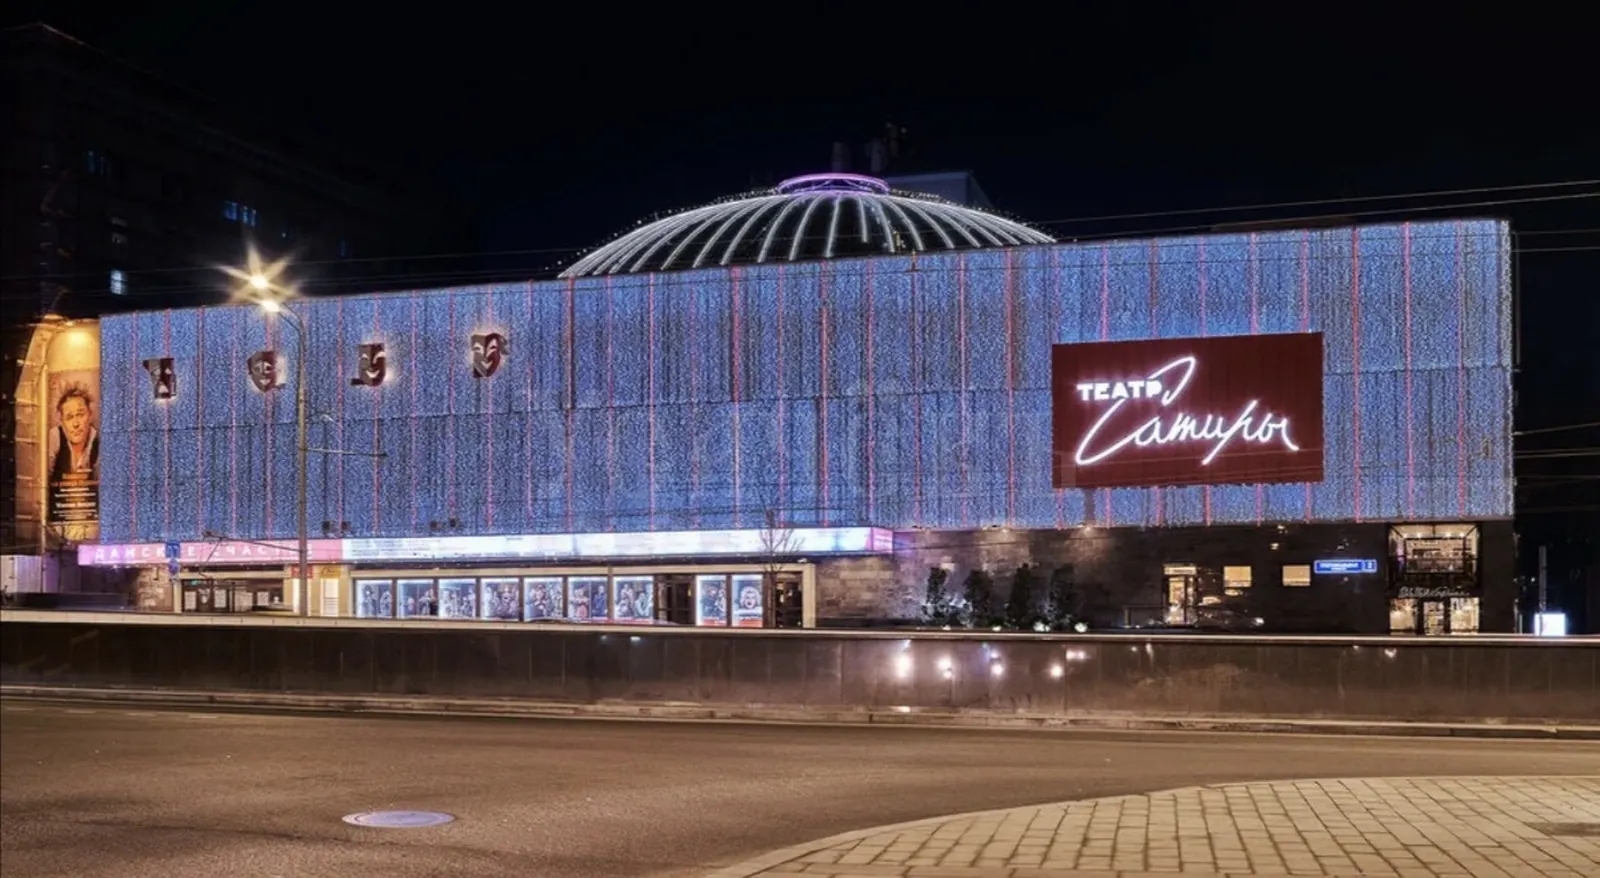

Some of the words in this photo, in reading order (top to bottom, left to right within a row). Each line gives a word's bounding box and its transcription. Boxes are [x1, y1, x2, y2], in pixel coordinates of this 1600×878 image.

[1076, 379, 1163, 401] ТЕАТР
[1075, 356, 1300, 466] Сатиры
[94, 545, 197, 561] ДАМСКЕ
